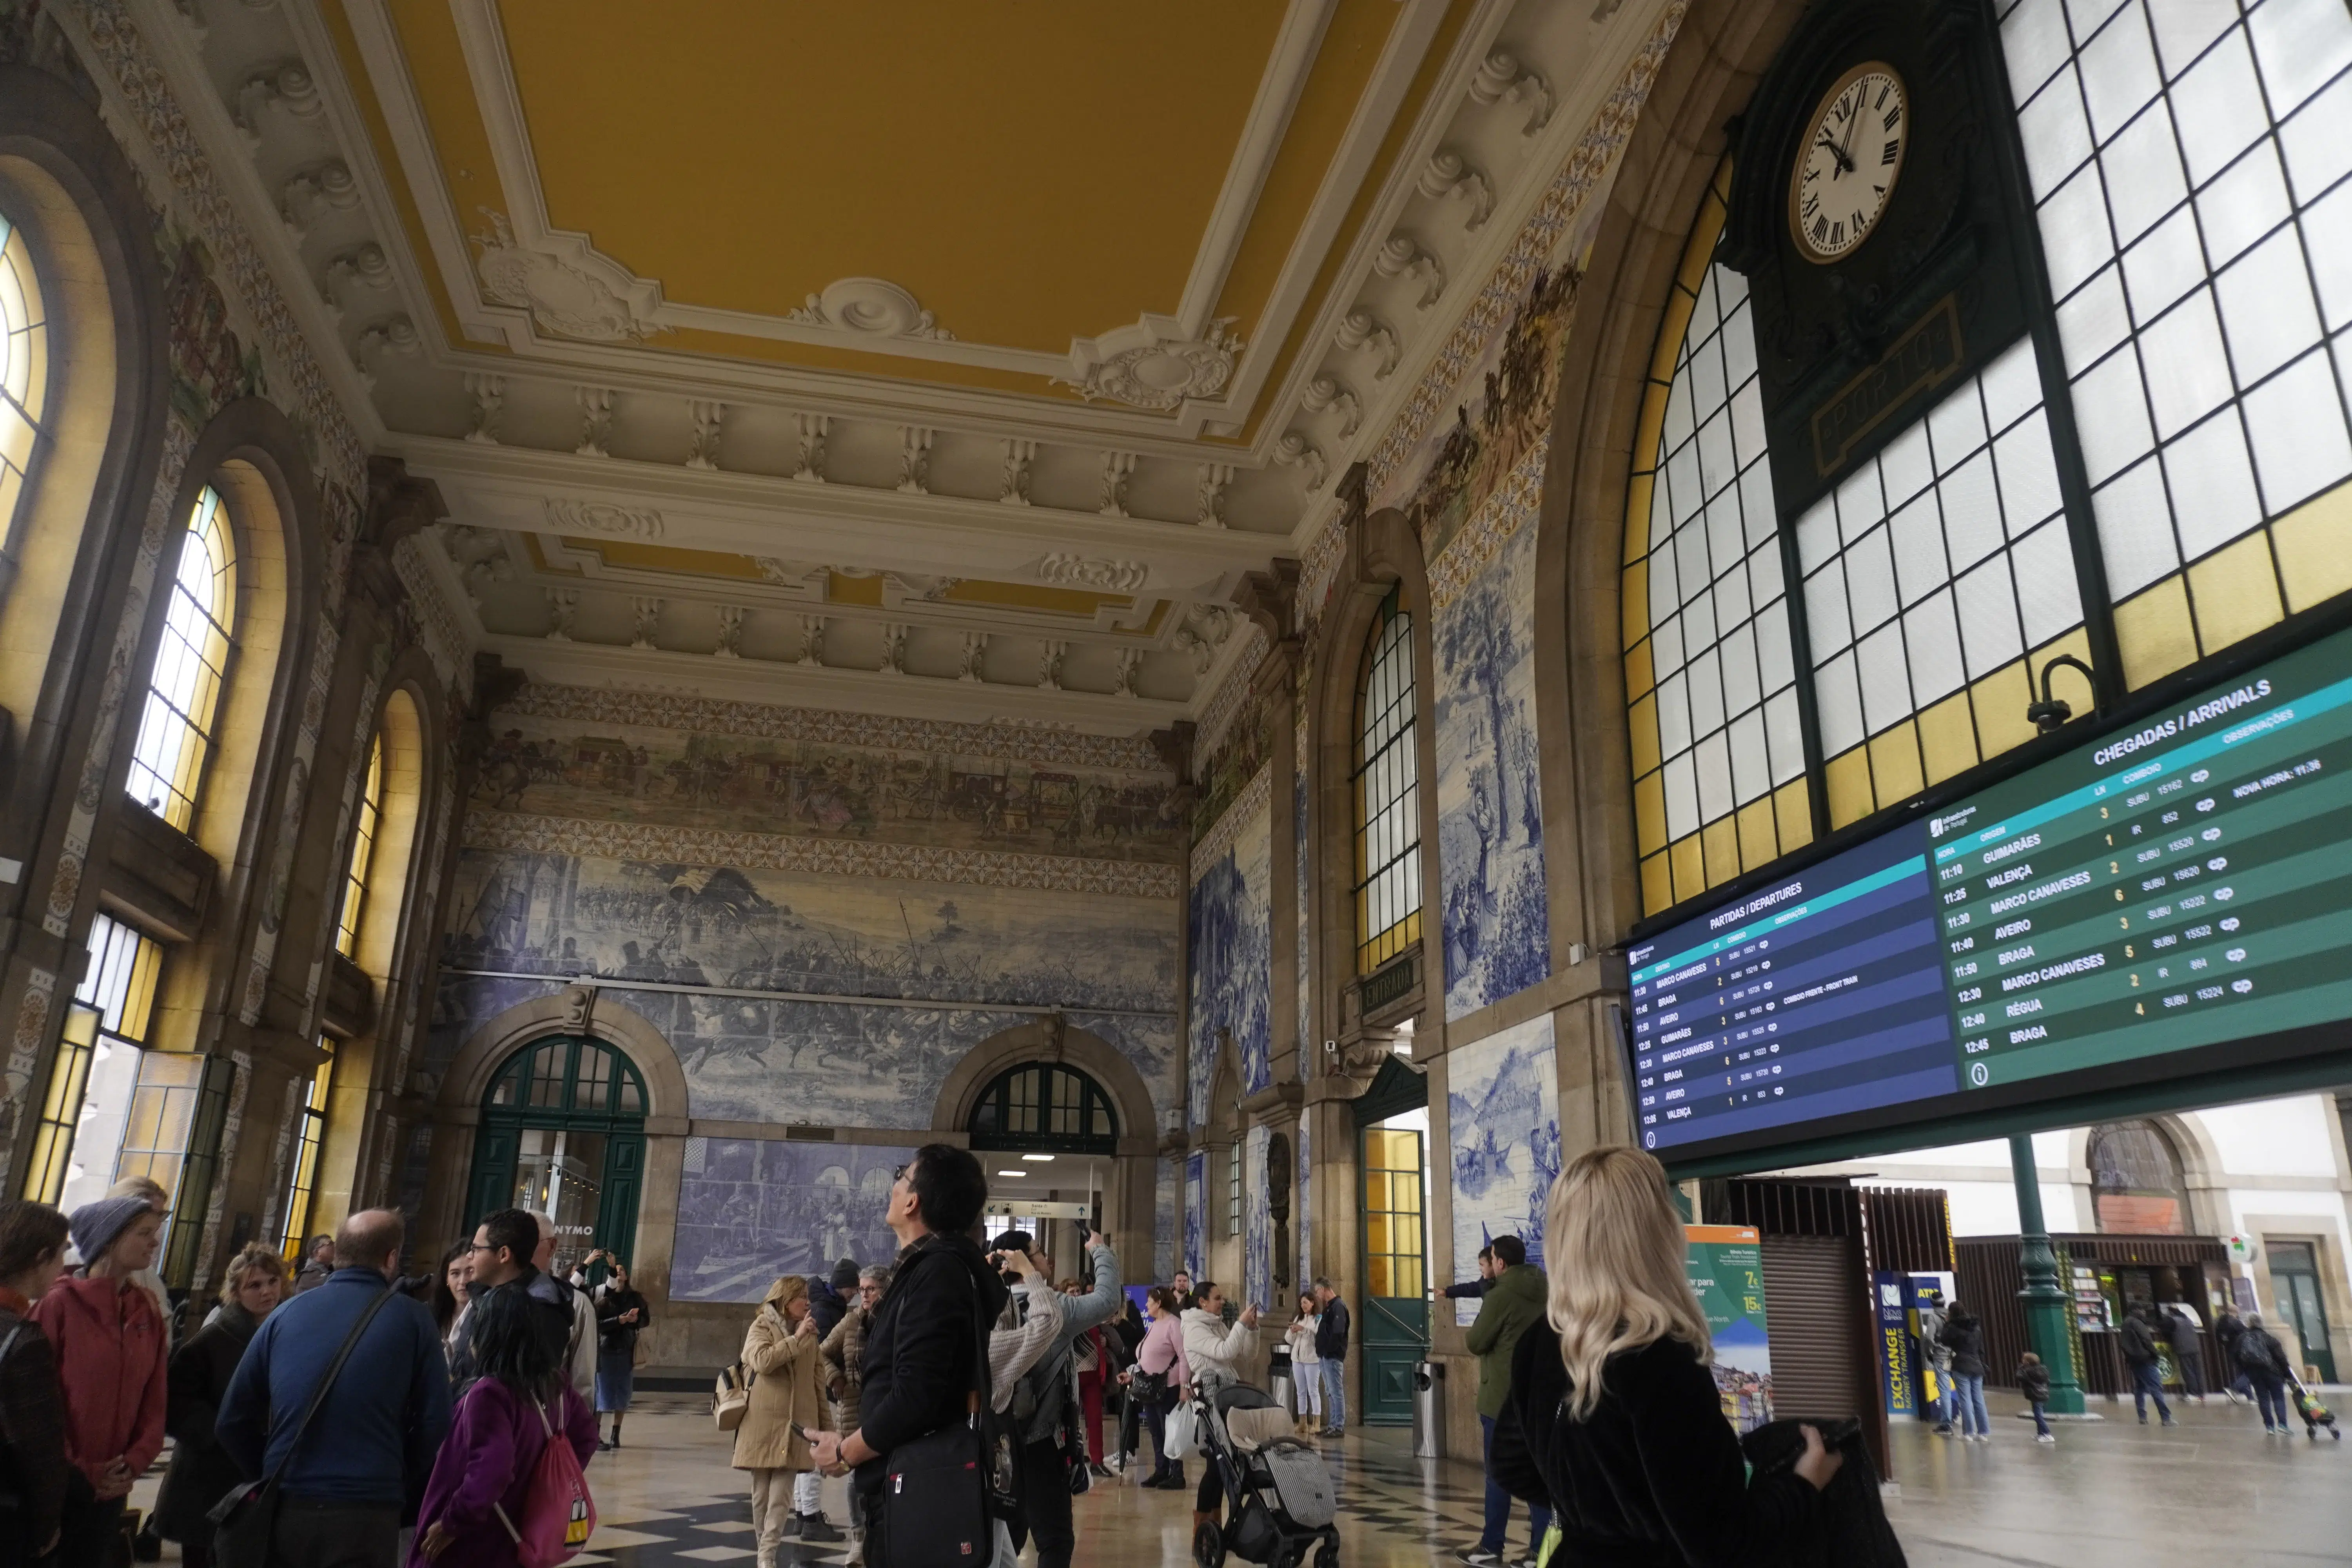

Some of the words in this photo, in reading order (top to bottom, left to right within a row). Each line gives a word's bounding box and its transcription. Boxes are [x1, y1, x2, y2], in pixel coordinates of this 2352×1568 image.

[1833, 331, 1932, 439] PORTO
[2094, 720, 2177, 765] CHEGADAS
[2187, 680, 2271, 727] ARRIVALS
[1938, 847, 1955, 859] HORA
[1980, 826, 2006, 842] ORIGEM
[2094, 785, 2106, 796] LN
[2123, 763, 2161, 784] COMBOIO
[2223, 709, 2294, 744] OBSERVAÇÕES
[1940, 864, 1963, 880] 11:10
[1983, 833, 2041, 864] GUIMARÃES
[2100, 807, 2109, 818] 3
[2127, 792, 2149, 807] SUBU
[2158, 779, 2183, 795] 15162
[1944, 887, 1966, 904] 11:25
[1986, 864, 2033, 888] VALENÇA
[2105, 834, 2112, 846] 1
[2131, 825, 2142, 835] IR
[2162, 811, 2179, 824] 852
[2233, 782, 2262, 798] NOVA
[2261, 771, 2294, 788] HORA:
[2294, 759, 2321, 776] 11:36
[1710, 907, 1745, 930] PARTIDAS
[1750, 882, 1802, 913] DEPARTURES
[1947, 913, 1970, 928] 11:30
[1991, 893, 2027, 914] MARCO
[2028, 871, 2091, 901] CANAVESES
[2110, 862, 2118, 874] 2
[2137, 848, 2160, 862] SUBU
[2168, 837, 2194, 851] 15520
[1951, 937, 1973, 953] 11:40
[1995, 919, 2031, 940] AVEIRO
[2115, 889, 2123, 901] 6
[2142, 877, 2165, 891] SUBU
[2173, 866, 2200, 881] 15620
[1955, 962, 1977, 978] 11:50
[1998, 946, 2035, 965] BRAGA
[2120, 917, 2128, 929] 3
[2148, 906, 2171, 919] SUBU
[2180, 895, 2206, 910] 15222
[1958, 987, 1982, 1002] 12:30
[2002, 971, 2040, 991] MARCO
[2040, 953, 2105, 980] CANAVESES
[2125, 945, 2134, 958] 5
[2152, 935, 2177, 948] SUBU
[2185, 925, 2212, 940] 15522
[1367, 964, 1410, 1007] ENTRADA
[1634, 986, 1646, 997] 11:30
[1657, 975, 1675, 989] MARCO
[1675, 963, 1707, 981] CANAVESES
[1716, 957, 1720, 966] 5
[1729, 951, 1740, 960] SUBU
[1635, 1004, 1648, 1015] 11:45
[1658, 994, 1677, 1007] BRAGA
[1718, 977, 1722, 986] 2
[1731, 971, 1742, 980] SUBU
[1962, 1013, 1985, 1028] 12:40
[2006, 999, 2043, 1017] RÉGUA
[2131, 974, 2139, 987] 2
[2158, 967, 2169, 978] IR
[2190, 958, 2207, 970] 864
[1637, 1022, 1649, 1033] 11:50
[1660, 1012, 1678, 1026] AVEIRO
[1720, 997, 1724, 1005] 6
[1733, 991, 1744, 1000] SUBU
[1638, 1040, 1651, 1051] 12:25
[1661, 1027, 1691, 1044] GUIMARÃES
[1722, 1016, 1726, 1025] 3
[1735, 1011, 1746, 1020] SUBU
[1784, 992, 1805, 1004] COMBOIO
[1805, 986, 1824, 998] FRENTE
[1826, 980, 1842, 991] FRONT
[1842, 975, 1858, 986] TRAIN
[1965, 1038, 1989, 1053] 12:45
[2010, 1025, 2047, 1044] BRAGA
[2135, 1003, 2144, 1015] 4
[2163, 994, 2188, 1007] SUBU
[2196, 986, 2223, 1000] 15224
[1640, 1059, 1652, 1069] 12:30
[1662, 1050, 1682, 1063] MARCO
[1682, 1040, 1714, 1057] CANAVESES
[1724, 1036, 1728, 1045] 3
[1737, 1031, 1748, 1040] SUBU
[1641, 1077, 1653, 1087] 12:40
[1664, 1069, 1683, 1082] BRAGA
[1725, 1056, 1730, 1065] 6
[1739, 1052, 1750, 1060] SUBU
[1642, 1096, 1655, 1106] 12:50
[1666, 1088, 1685, 1101] AVEIRO
[1727, 1076, 1731, 1085] 5
[1740, 1073, 1752, 1081] SUBU
[1644, 1114, 1656, 1125] 13:05
[1667, 1107, 1691, 1119] VALENÇA
[1729, 1097, 1732, 1105] 1
[1697, 1279, 1715, 1288] para
[1885, 1327, 1905, 1409] EXCHANGE
[1897, 1327, 1908, 1373] TRANSFER
[1902, 1375, 1913, 1409] MONEY
